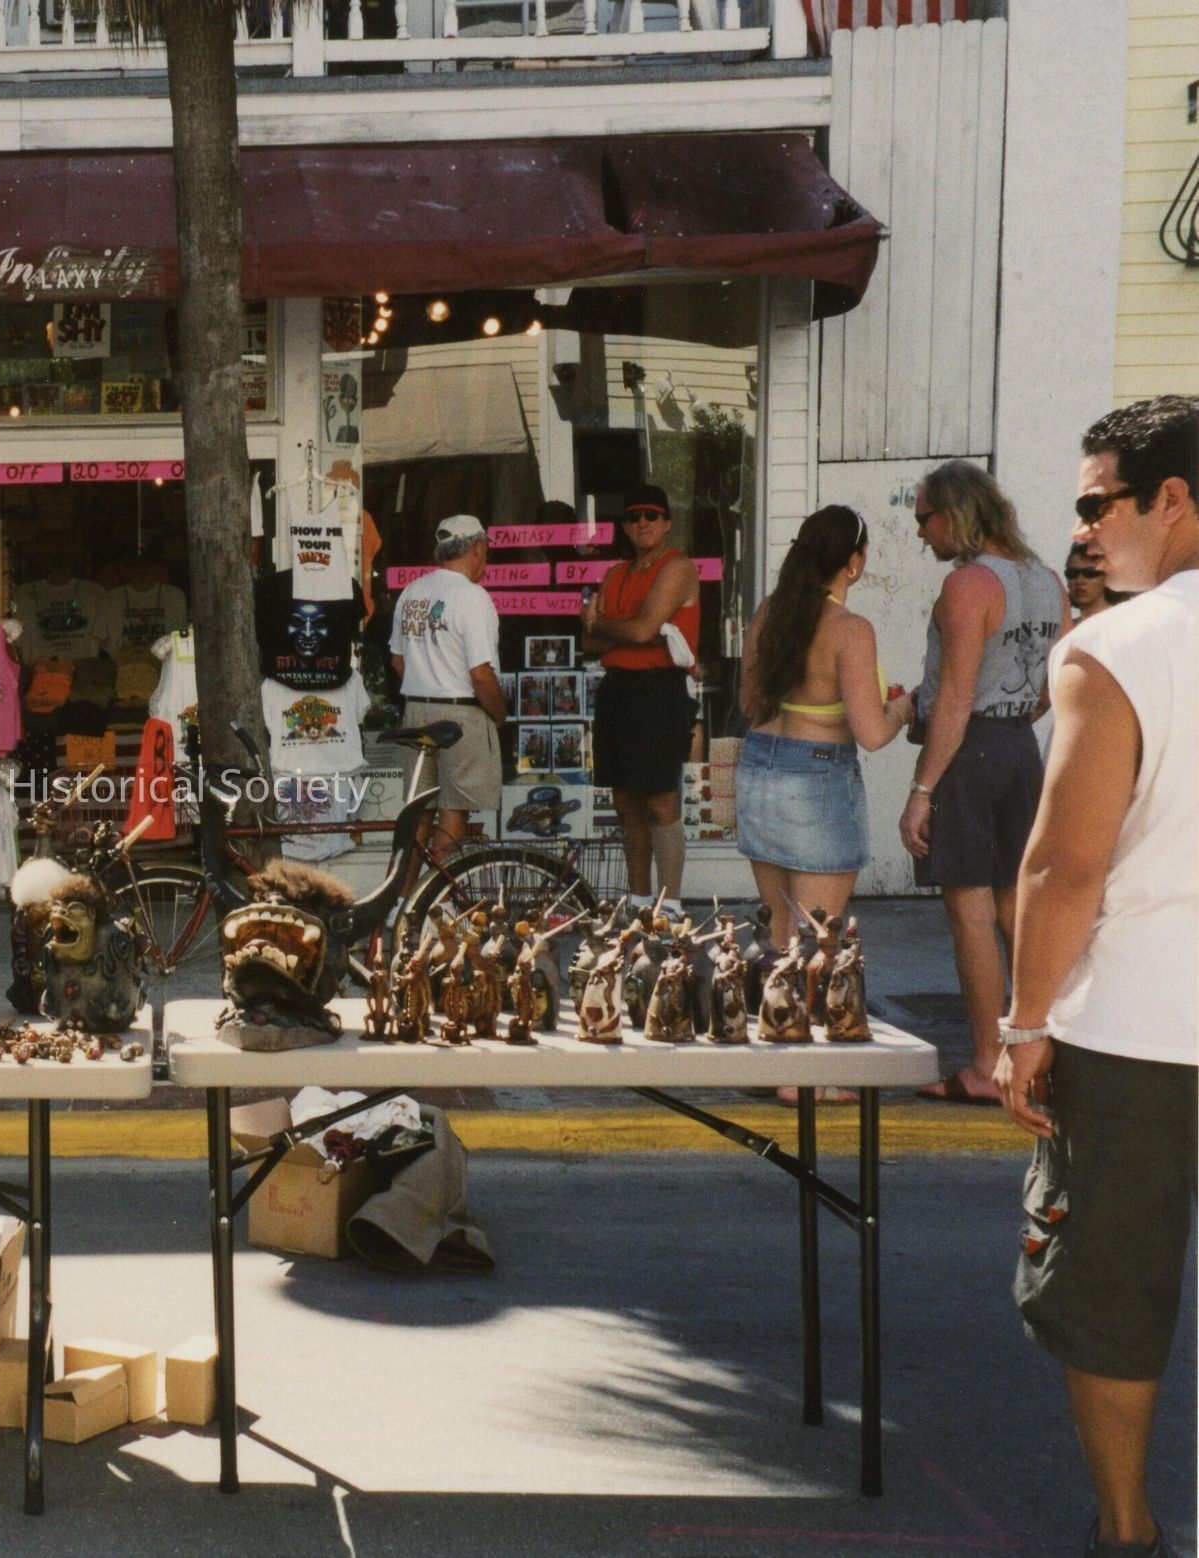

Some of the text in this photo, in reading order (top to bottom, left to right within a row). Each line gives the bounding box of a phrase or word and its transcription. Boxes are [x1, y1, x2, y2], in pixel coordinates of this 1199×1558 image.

[6, 464, 44, 481] OFF
[73, 461, 149, 480] 20-50%
[326, 527, 343, 537] ME
[297, 540, 332, 551] YOUR
[566, 565, 588, 579] BY
